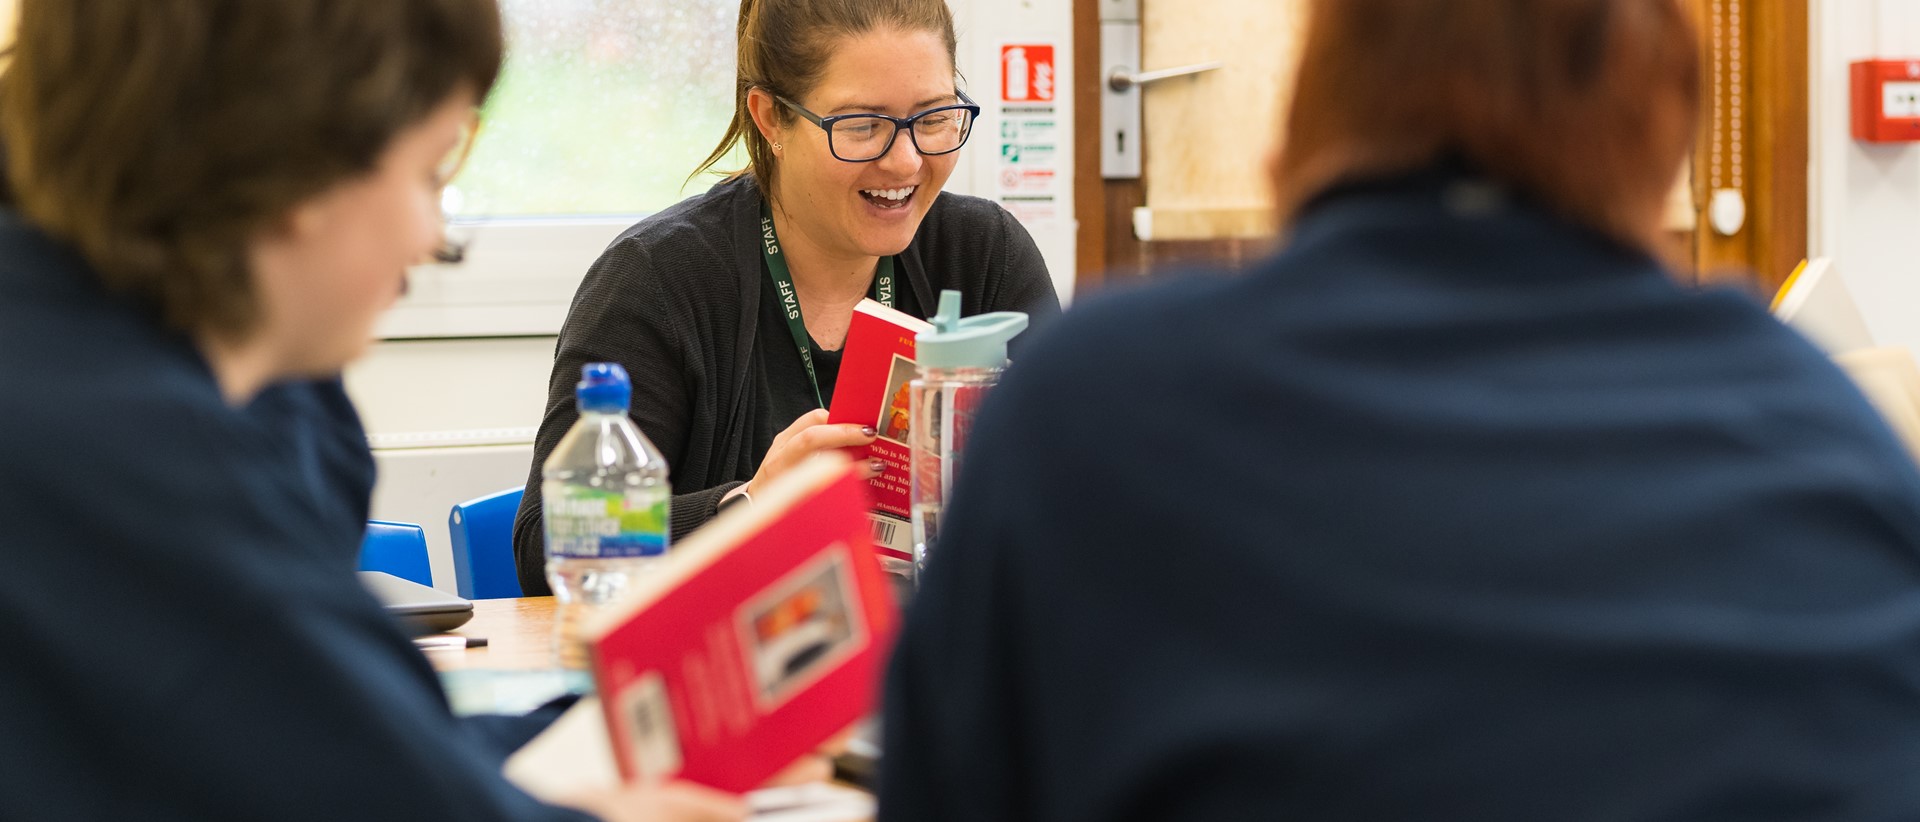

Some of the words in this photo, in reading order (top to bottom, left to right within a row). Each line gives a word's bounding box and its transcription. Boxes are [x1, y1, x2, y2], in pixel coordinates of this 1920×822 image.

[761, 217, 779, 255] STAFF
[778, 280, 799, 320] STAFF
[799, 346, 813, 377] TAFF
[884, 474, 896, 482] am
[901, 464, 911, 472] de
[870, 478, 885, 488] This
[895, 486, 908, 496] my
